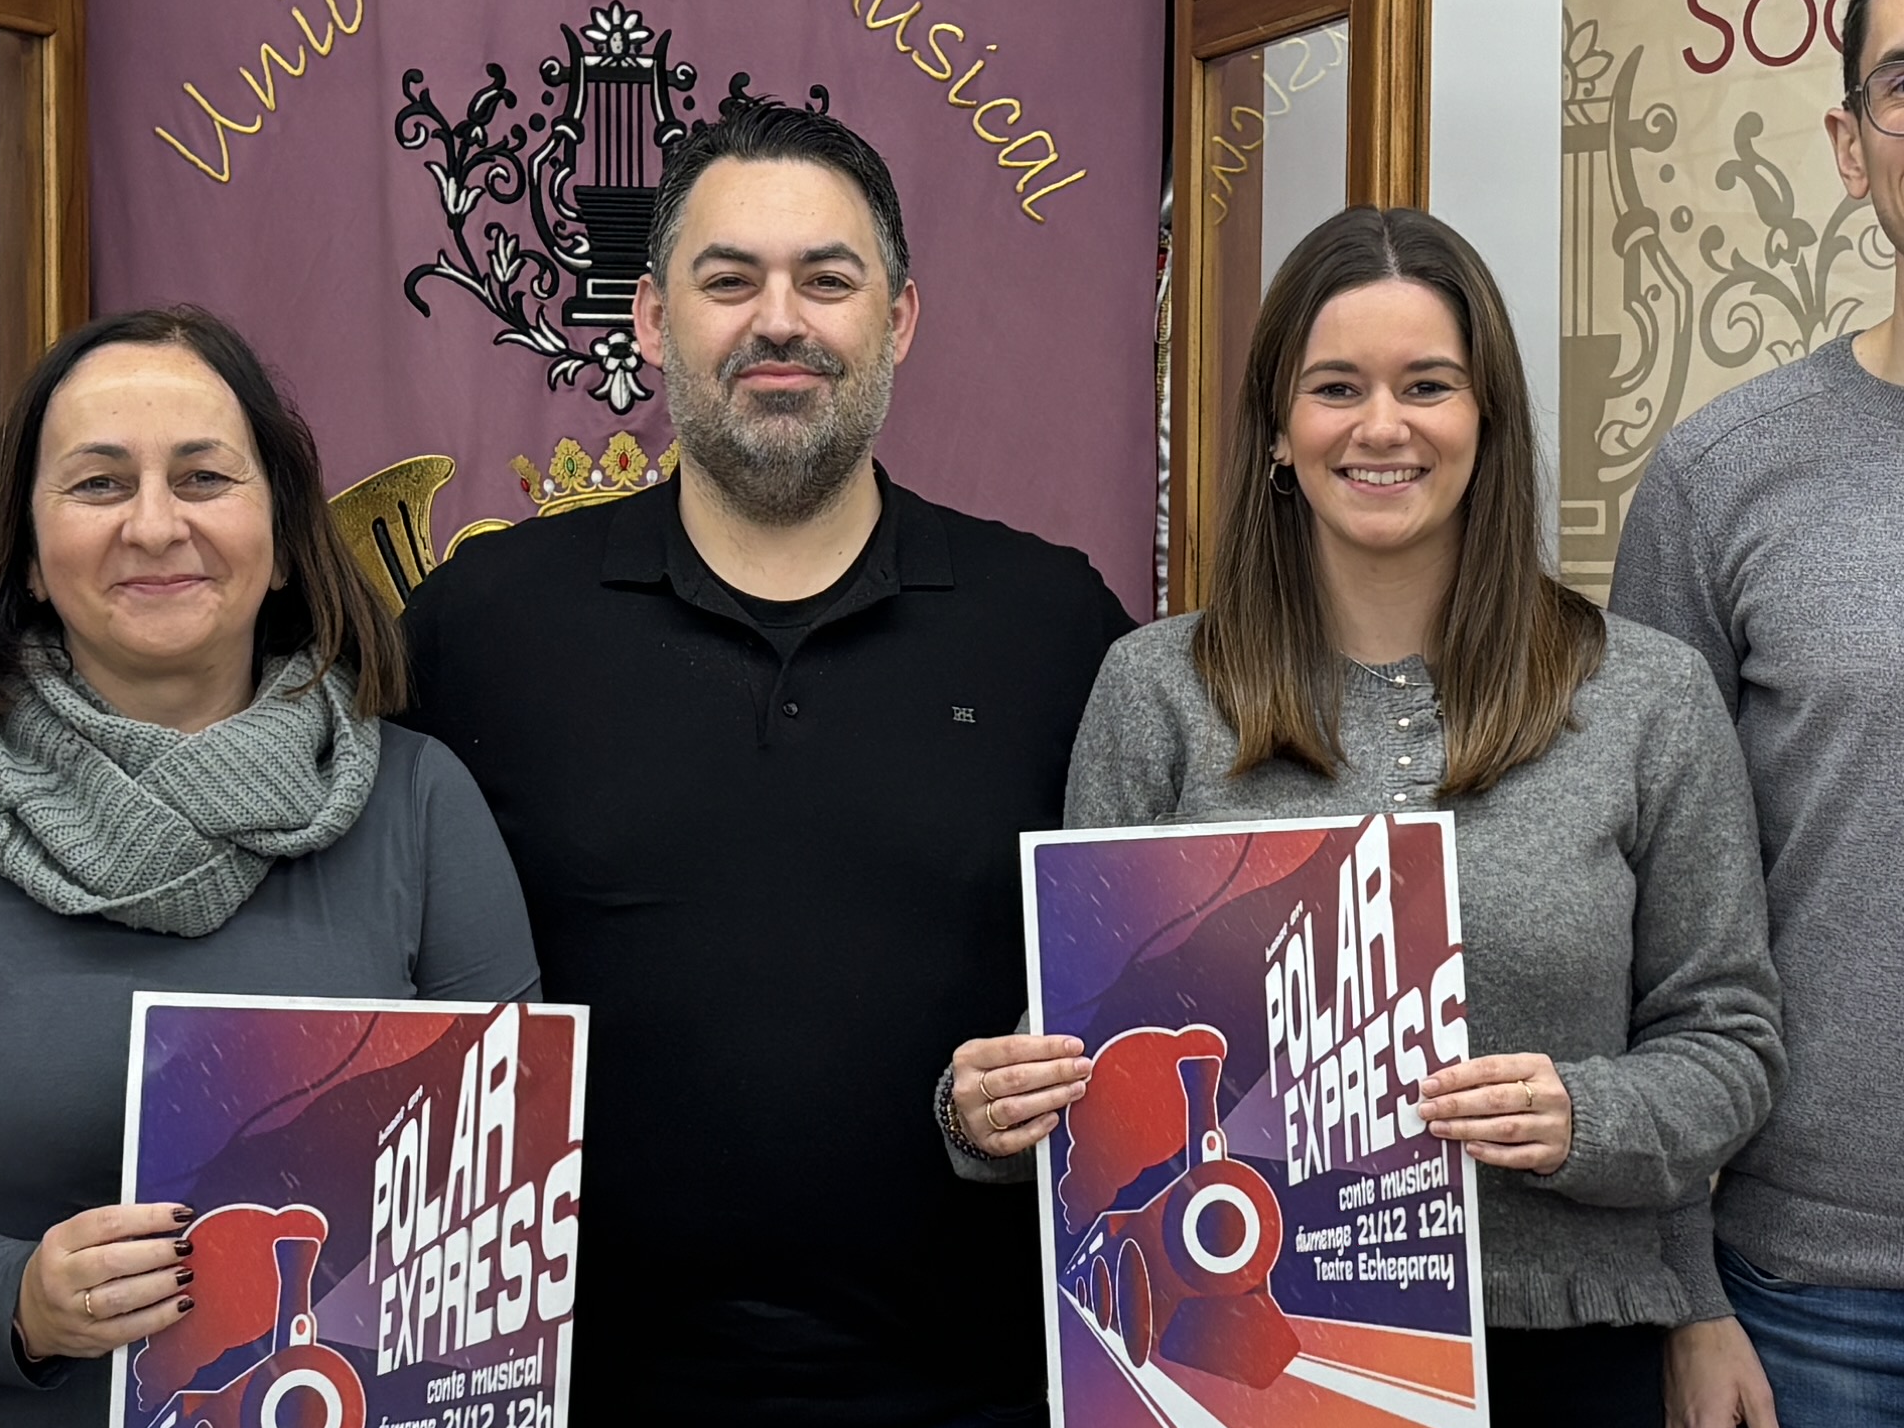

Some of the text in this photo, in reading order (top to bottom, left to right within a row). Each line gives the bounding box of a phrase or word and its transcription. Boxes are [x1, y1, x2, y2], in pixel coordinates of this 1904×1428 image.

[1265, 813, 1398, 1098] POLAR
[368, 1002, 520, 1286] POLAR
[1338, 1141, 1448, 1211] conte musical
[1296, 1193, 1464, 1256] dumenge 21/12 12h
[377, 1148, 582, 1376] EXPRESS
[1314, 1254, 1454, 1289] Teatre Echegaray
[427, 1338, 544, 1404] conte musical
